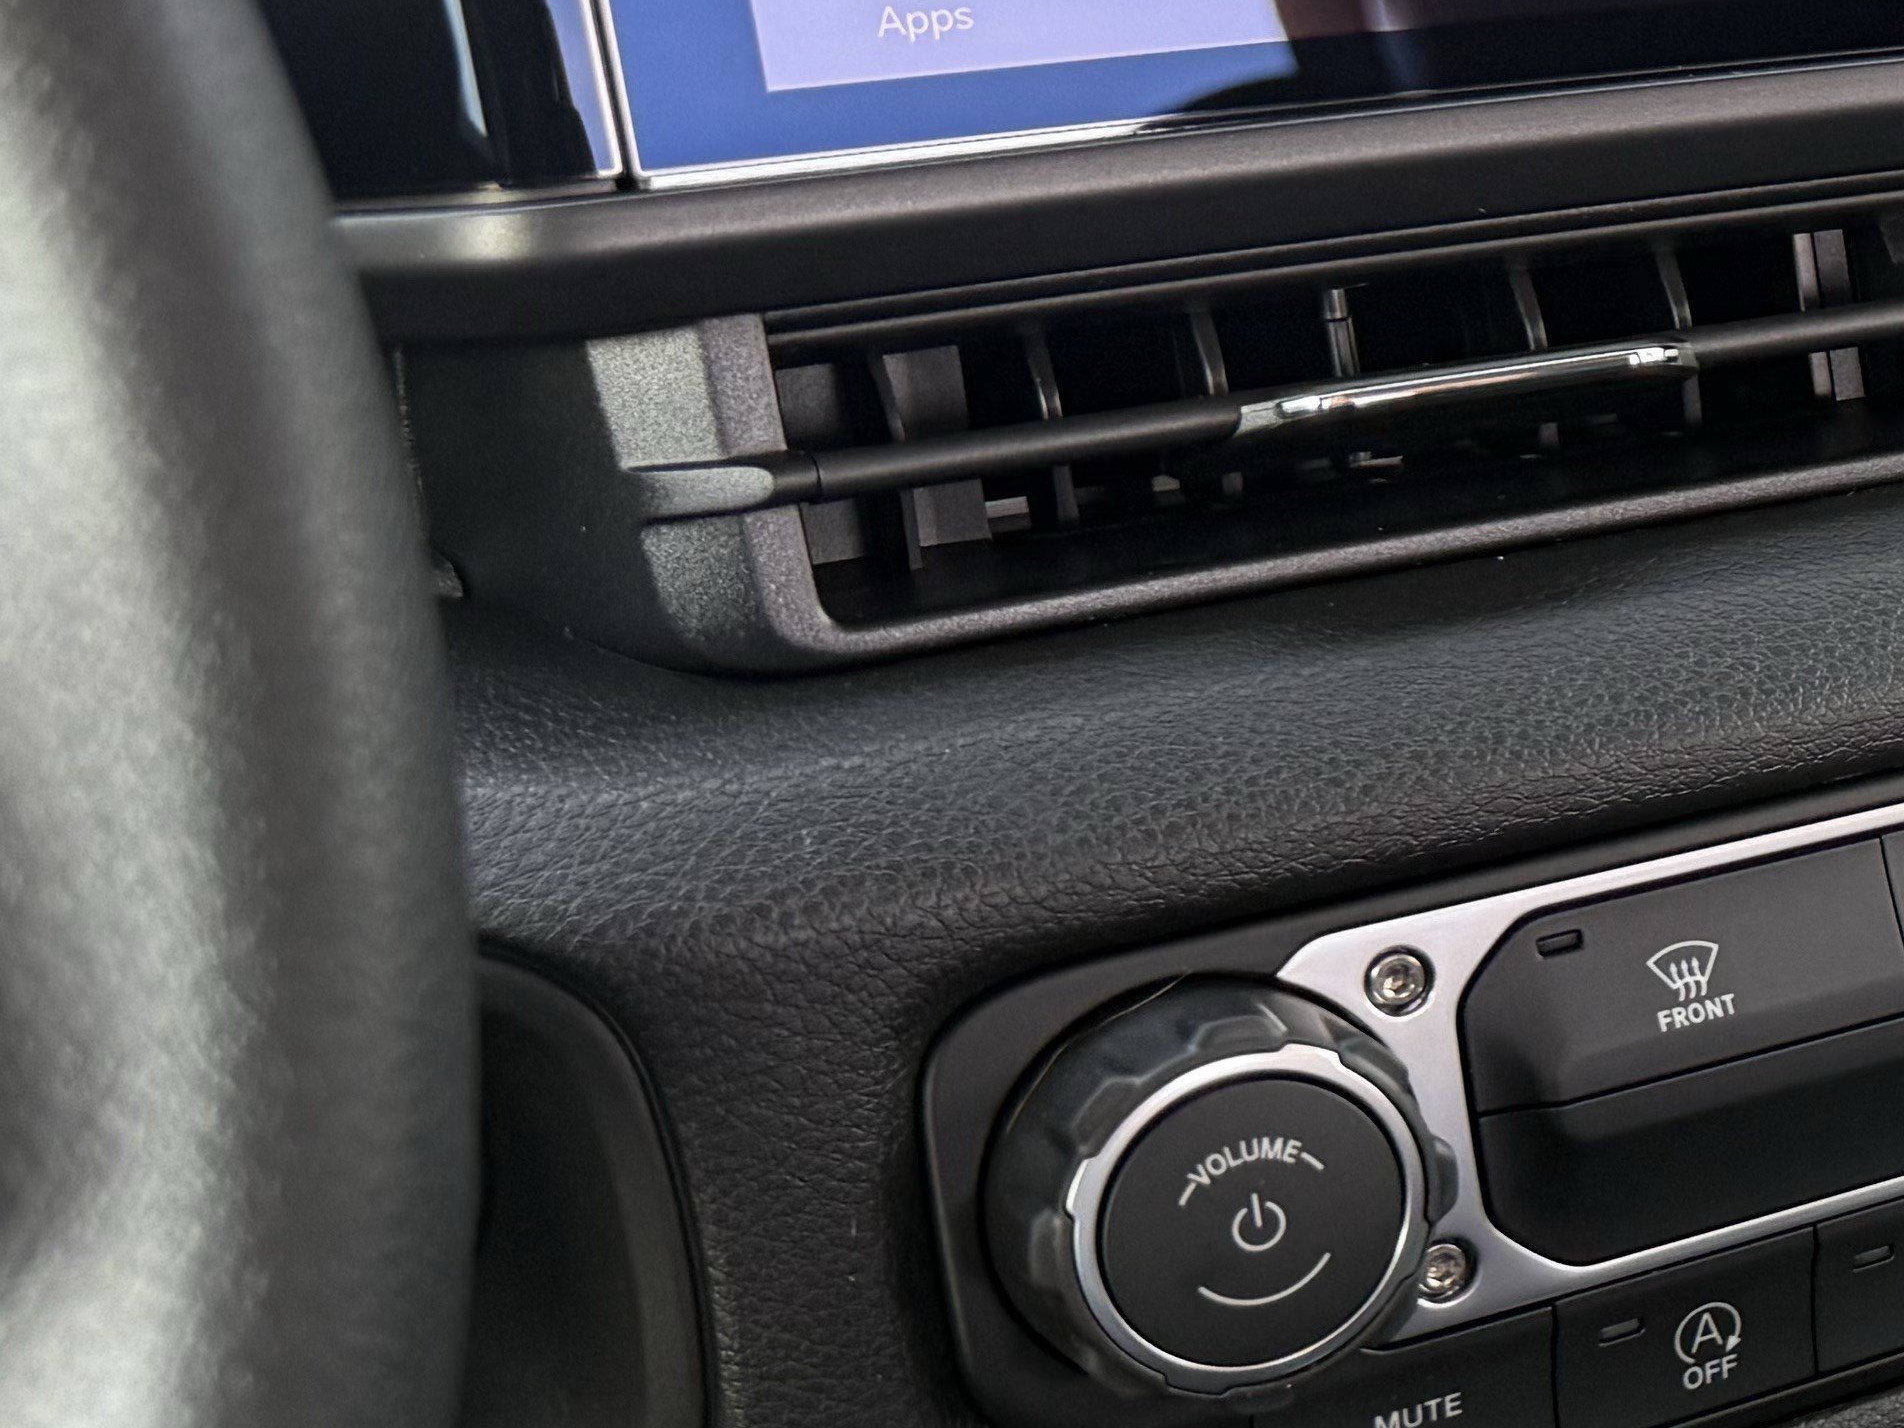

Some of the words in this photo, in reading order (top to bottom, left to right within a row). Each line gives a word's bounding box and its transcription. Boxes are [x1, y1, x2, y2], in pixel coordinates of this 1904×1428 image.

[877, 1, 976, 42] Apps
[1656, 992, 1736, 1033] FRONT
[1187, 1135, 1303, 1189] VOLUME
[1683, 1353, 1739, 1390] OFF
